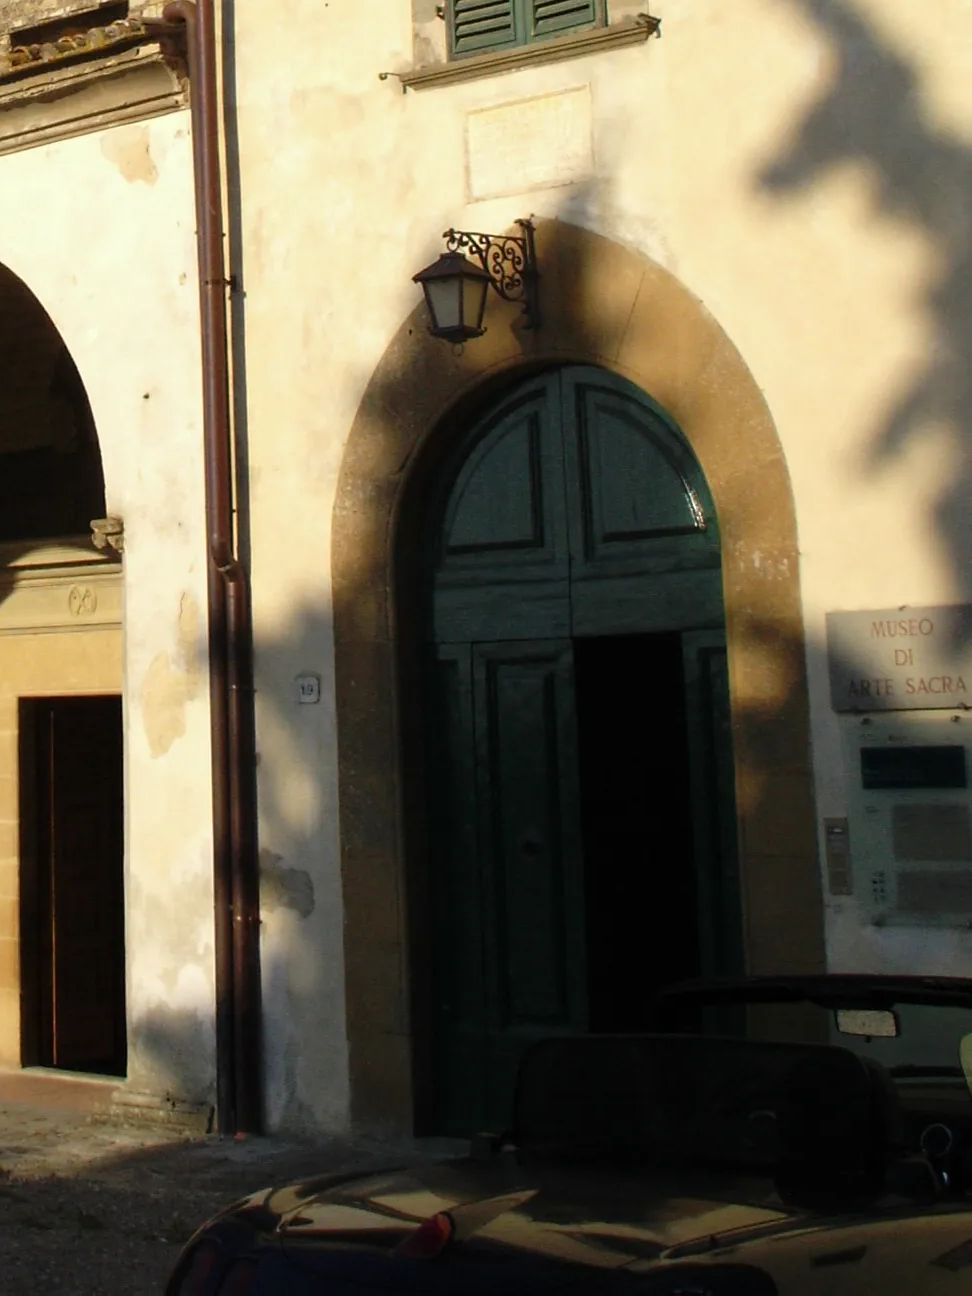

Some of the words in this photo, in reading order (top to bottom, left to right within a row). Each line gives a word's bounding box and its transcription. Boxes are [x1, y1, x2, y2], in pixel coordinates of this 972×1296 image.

[871, 618, 934, 638] MUSEO
[894, 649, 915, 666] DI
[847, 679, 895, 697] ARTE
[906, 676, 968, 694] SACRA
